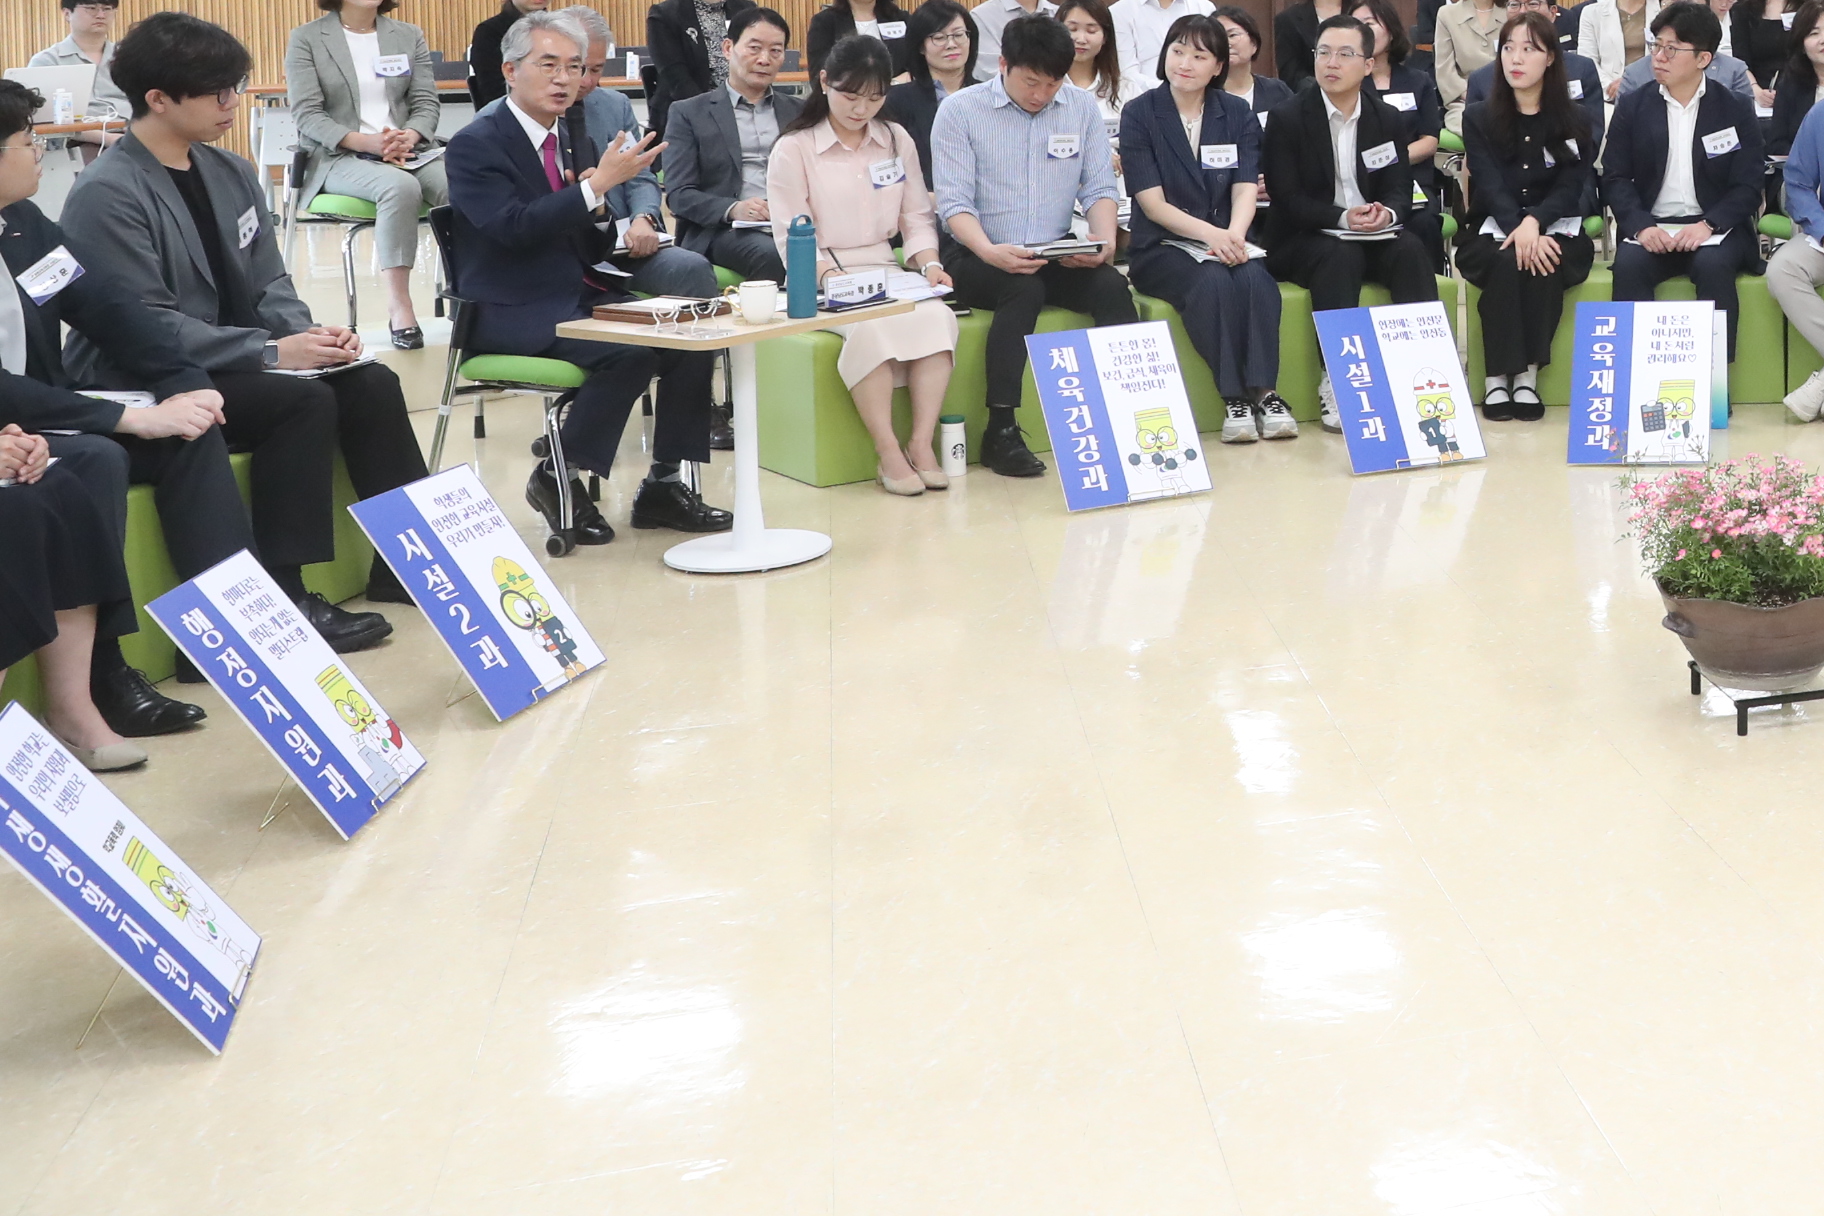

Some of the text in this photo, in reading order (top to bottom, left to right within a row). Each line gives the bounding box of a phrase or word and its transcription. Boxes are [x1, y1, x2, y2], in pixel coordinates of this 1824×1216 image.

[857, 282, 883, 295] 박종훈
[1378, 318, 1414, 330] 현장에는
[1657, 315, 1689, 325] 내 돈은
[1108, 337, 1156, 353] 든든한 몸!
[1381, 330, 1418, 342] 학교에는
[1650, 340, 1694, 350] 내 돈처럼
[1113, 351, 1160, 366] 건강한 삶!
[1148, 363, 1176, 375] 체육이
[1120, 378, 1166, 393] 책임진다!
[1340, 335, 1387, 442] 시설1과
[1584, 316, 1617, 450] 교육재정과
[1049, 346, 1109, 492] 체육건강과
[1428, 427, 1437, 438] 1
[433, 487, 472, 509] 학생들의
[431, 497, 496, 532] 안전한 교육시설
[446, 515, 505, 547] 우리가 만들자!
[221, 576, 263, 606] 한마디로는
[396, 527, 509, 670] 시설2과
[239, 593, 277, 622] 부족하다!
[276, 608, 297, 626] 없는
[268, 626, 308, 660] 멀티스트랩
[554, 629, 567, 644] 2
[180, 607, 358, 803] 행정지원과
[5, 732, 49, 782] 안전한 학교는
[28, 769, 56, 801] 우리의
[0, 796, 227, 1023] 생생활지원과
